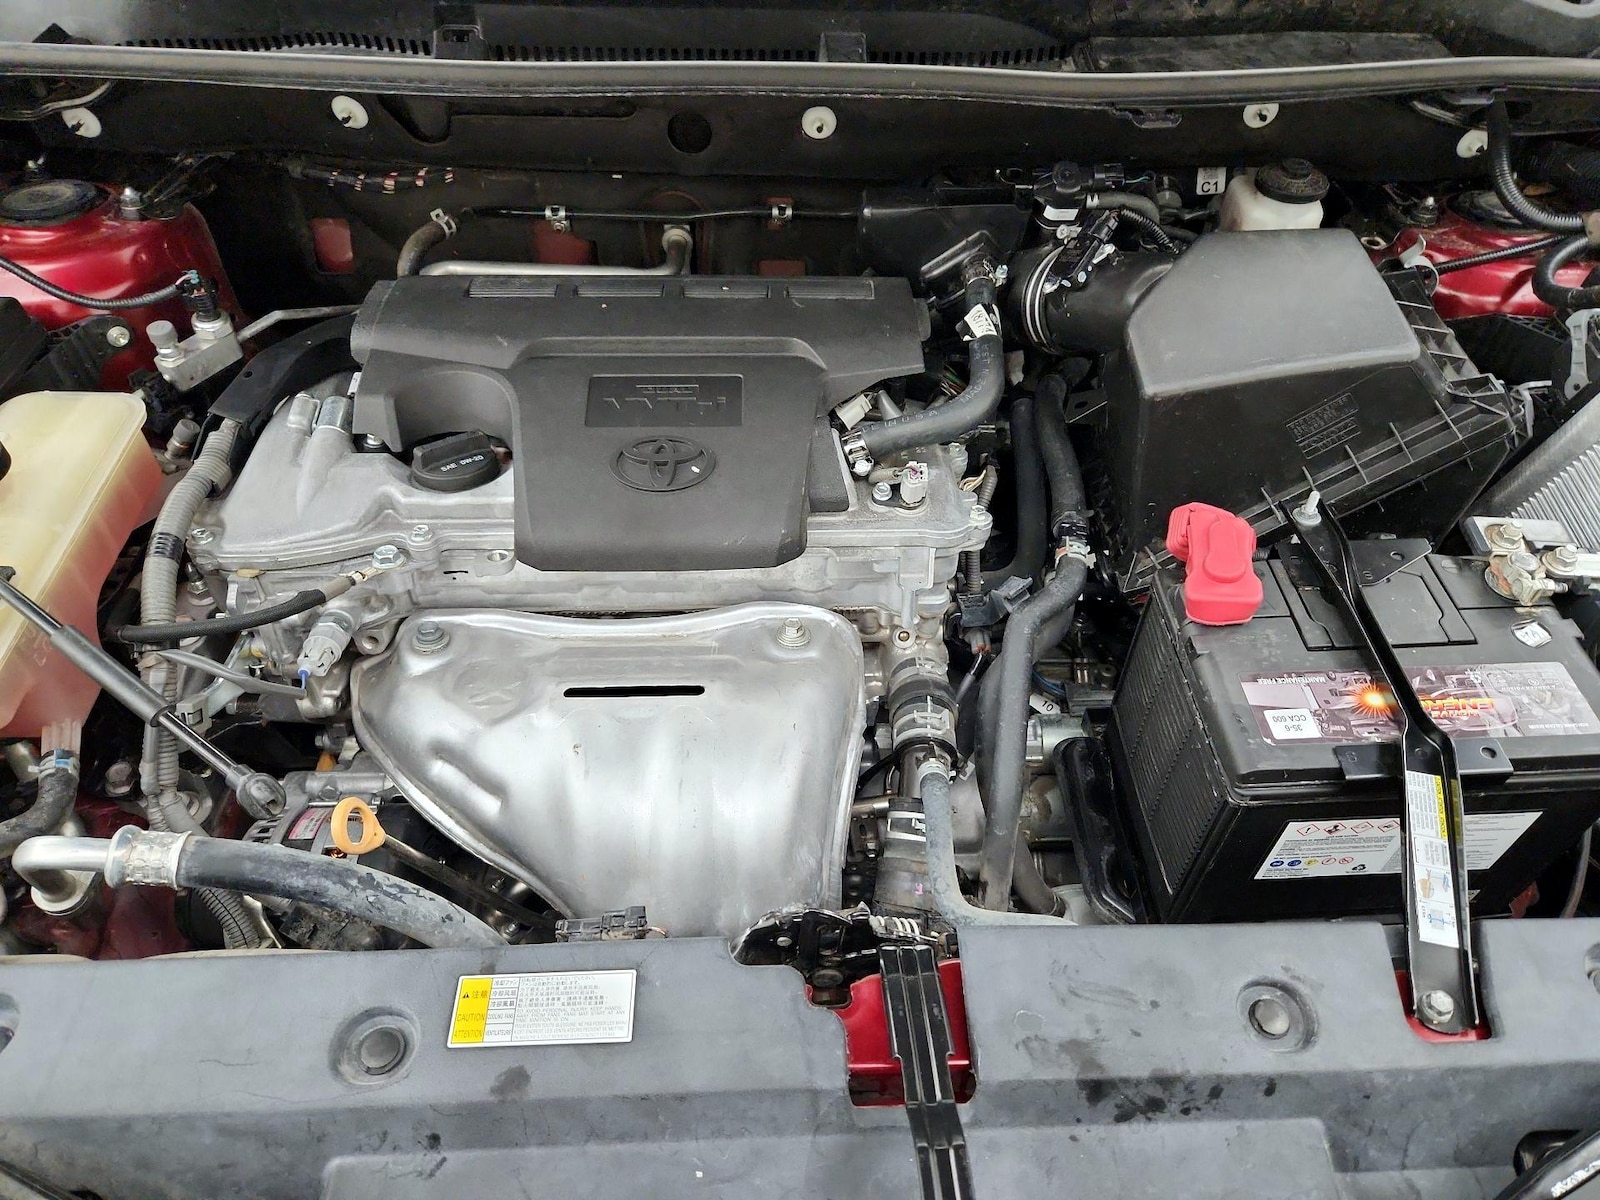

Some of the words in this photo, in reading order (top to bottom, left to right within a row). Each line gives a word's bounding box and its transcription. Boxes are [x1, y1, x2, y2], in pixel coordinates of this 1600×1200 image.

[1202, 180, 1218, 193] C1
[440, 462, 458, 472] SAE
[460, 454, 484, 465] 0W-20
[1277, 676, 1327, 684] MAINTENANCE
[1042, 700, 1054, 712] 10
[1284, 724, 1303, 732] 35-6
[457, 1013, 486, 1021] CAUTION
[454, 1030, 482, 1038] ATTENTION
